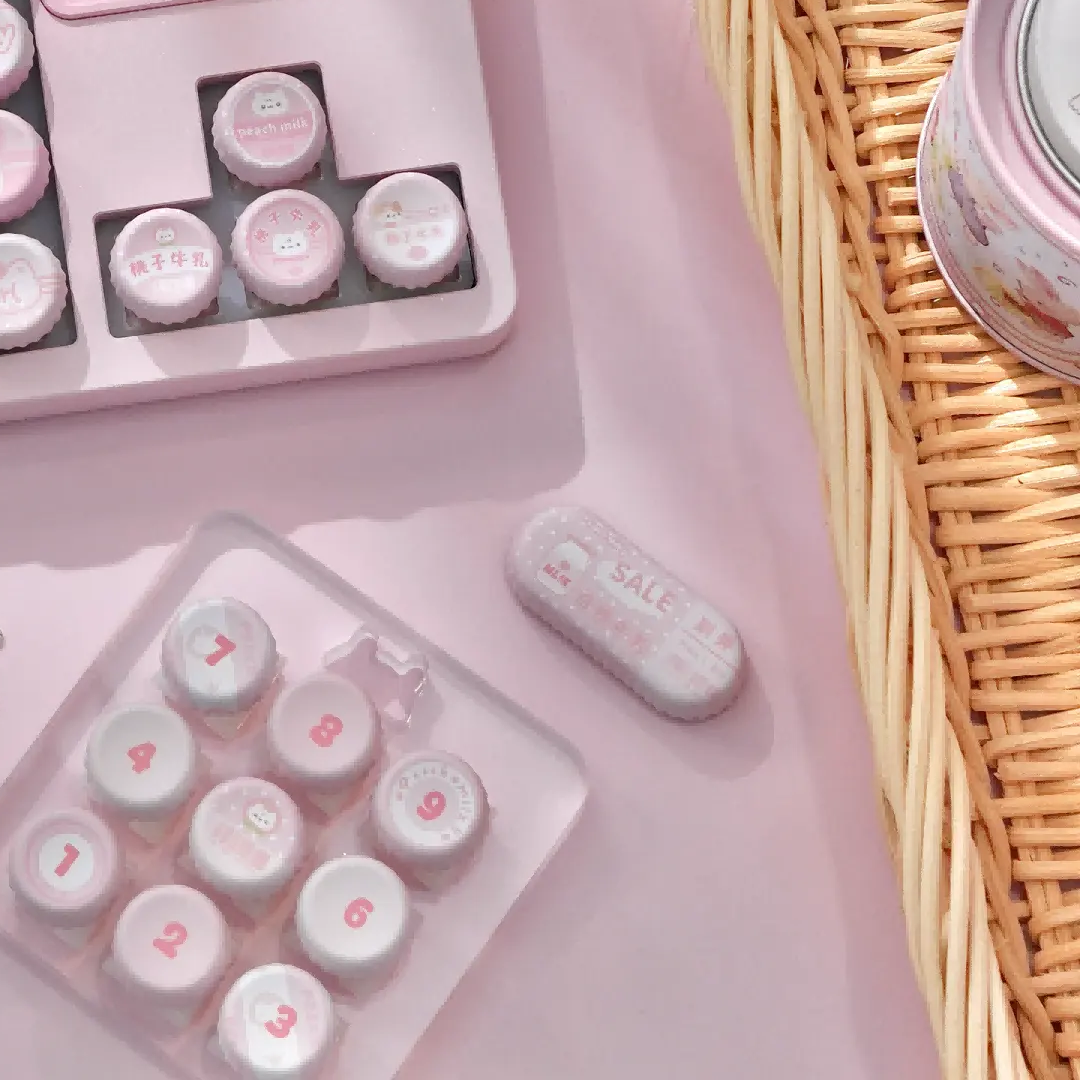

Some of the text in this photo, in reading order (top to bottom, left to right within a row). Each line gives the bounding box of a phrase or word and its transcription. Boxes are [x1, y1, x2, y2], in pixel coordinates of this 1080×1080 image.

[608, 562, 676, 613] SALE
[206, 634, 236, 667] 7
[309, 714, 343, 748] 8
[127, 742, 157, 773] 4
[416, 791, 446, 821] 9
[55, 844, 79, 877] 1
[343, 898, 373, 929] 6
[152, 922, 188, 959] 2
[264, 1005, 297, 1039] 3
